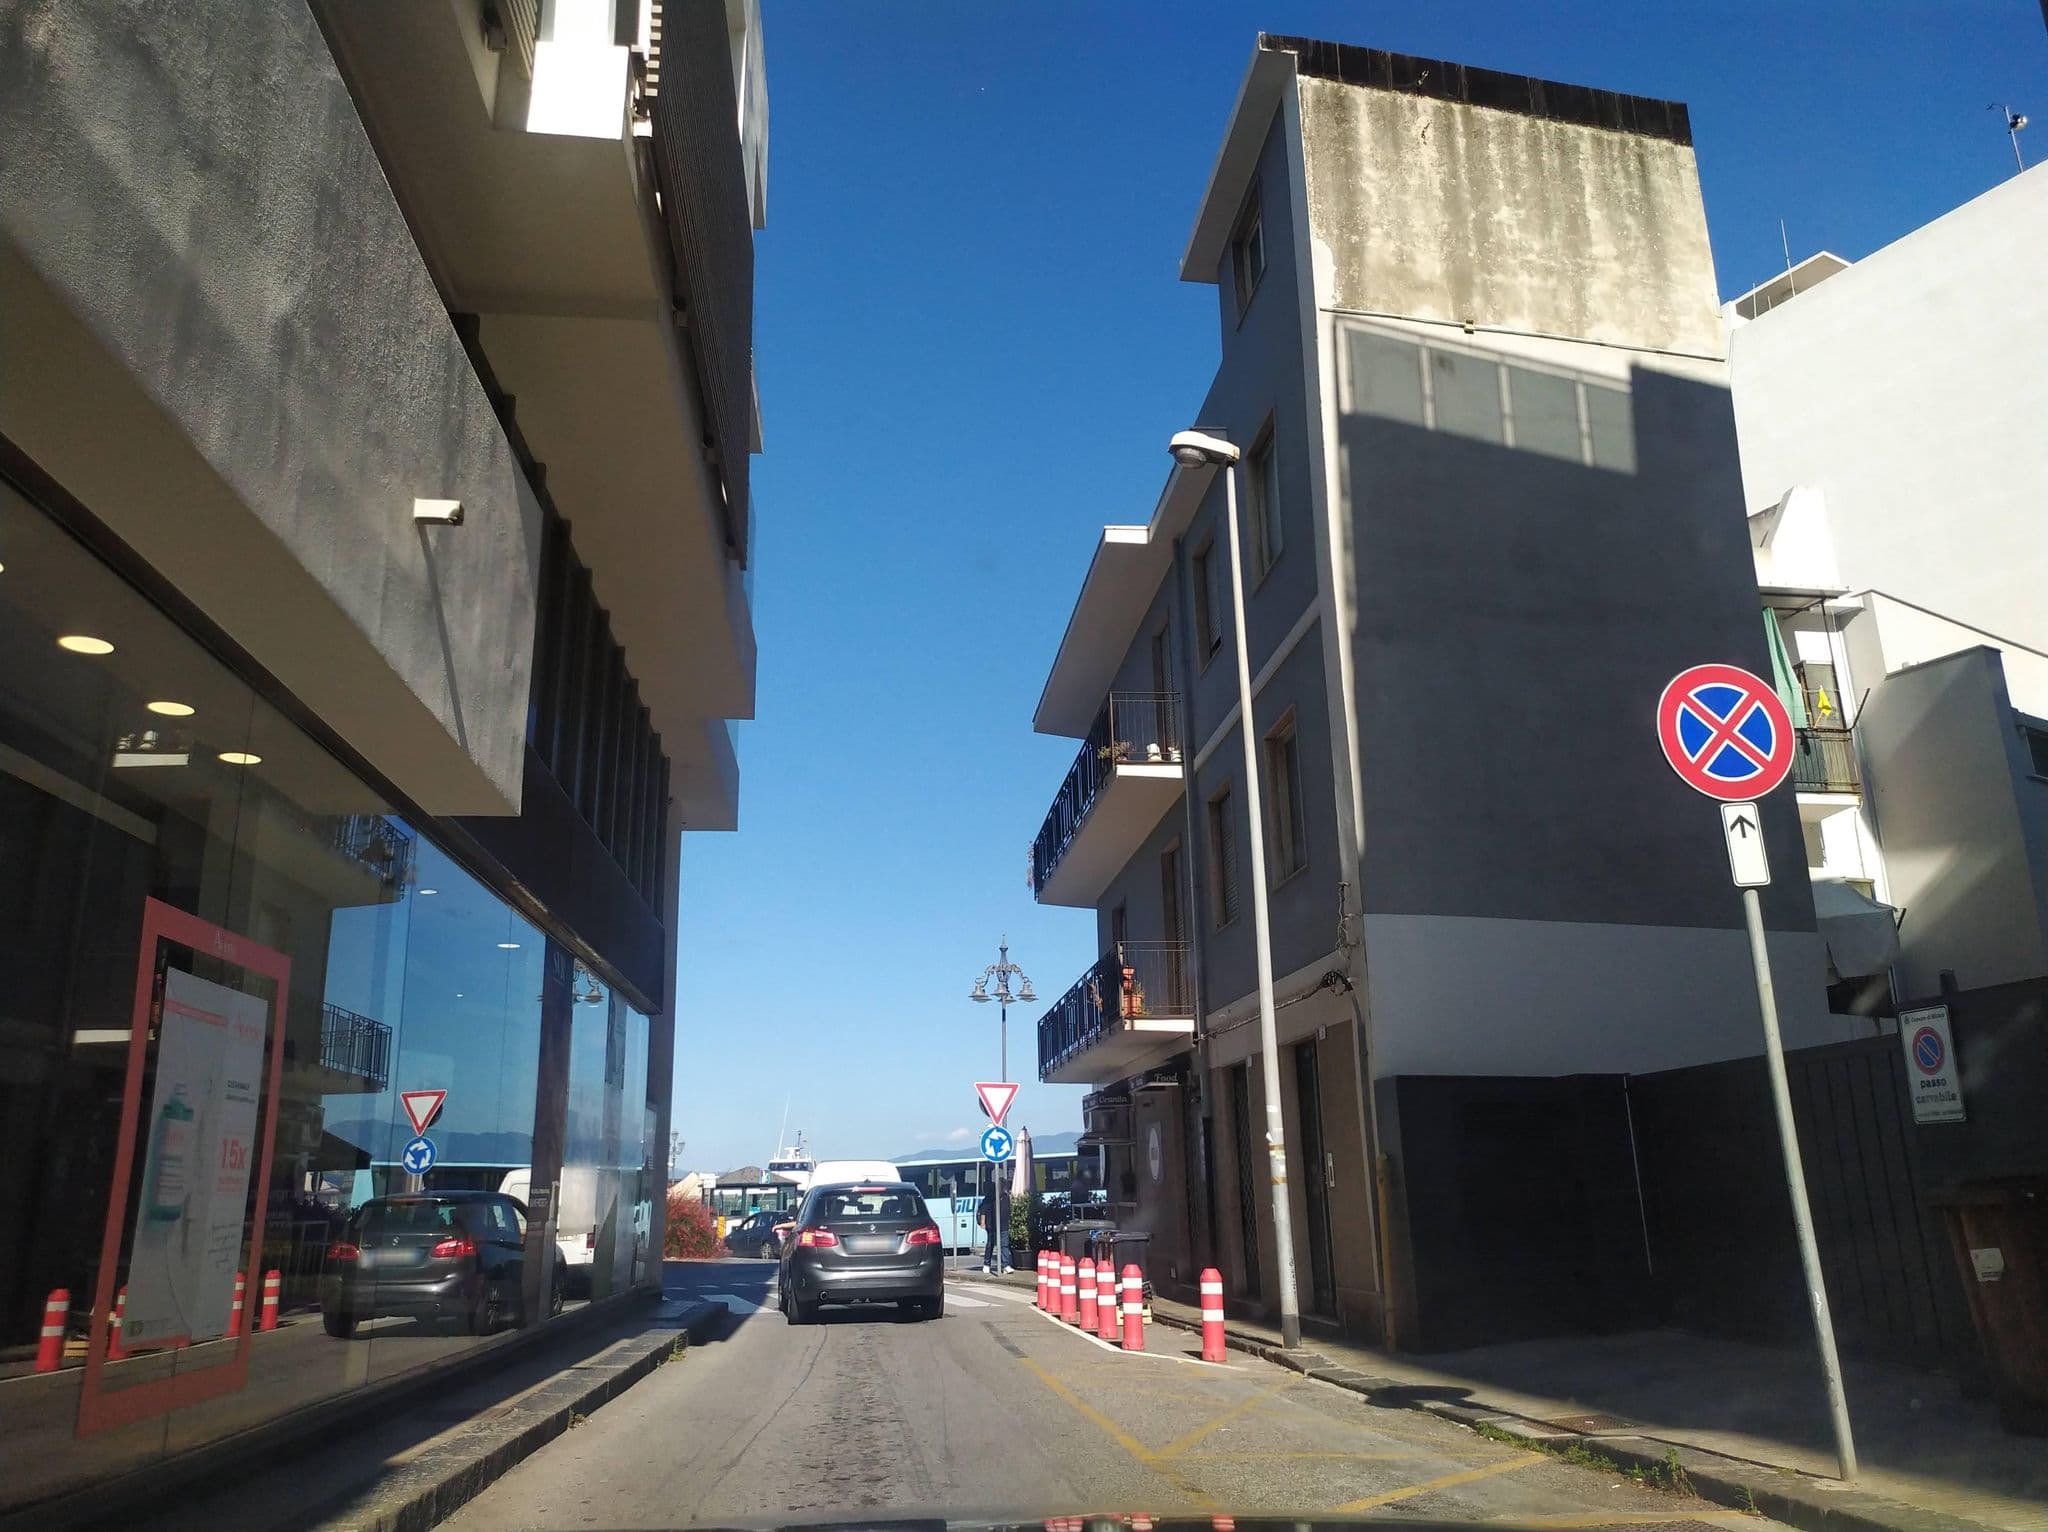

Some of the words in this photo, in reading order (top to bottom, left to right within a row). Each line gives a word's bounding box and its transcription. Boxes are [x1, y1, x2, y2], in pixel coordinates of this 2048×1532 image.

[1154, 1072, 1178, 1082] Food
[1920, 1079, 1947, 1089] passo
[1915, 1091, 1957, 1104] carrabile
